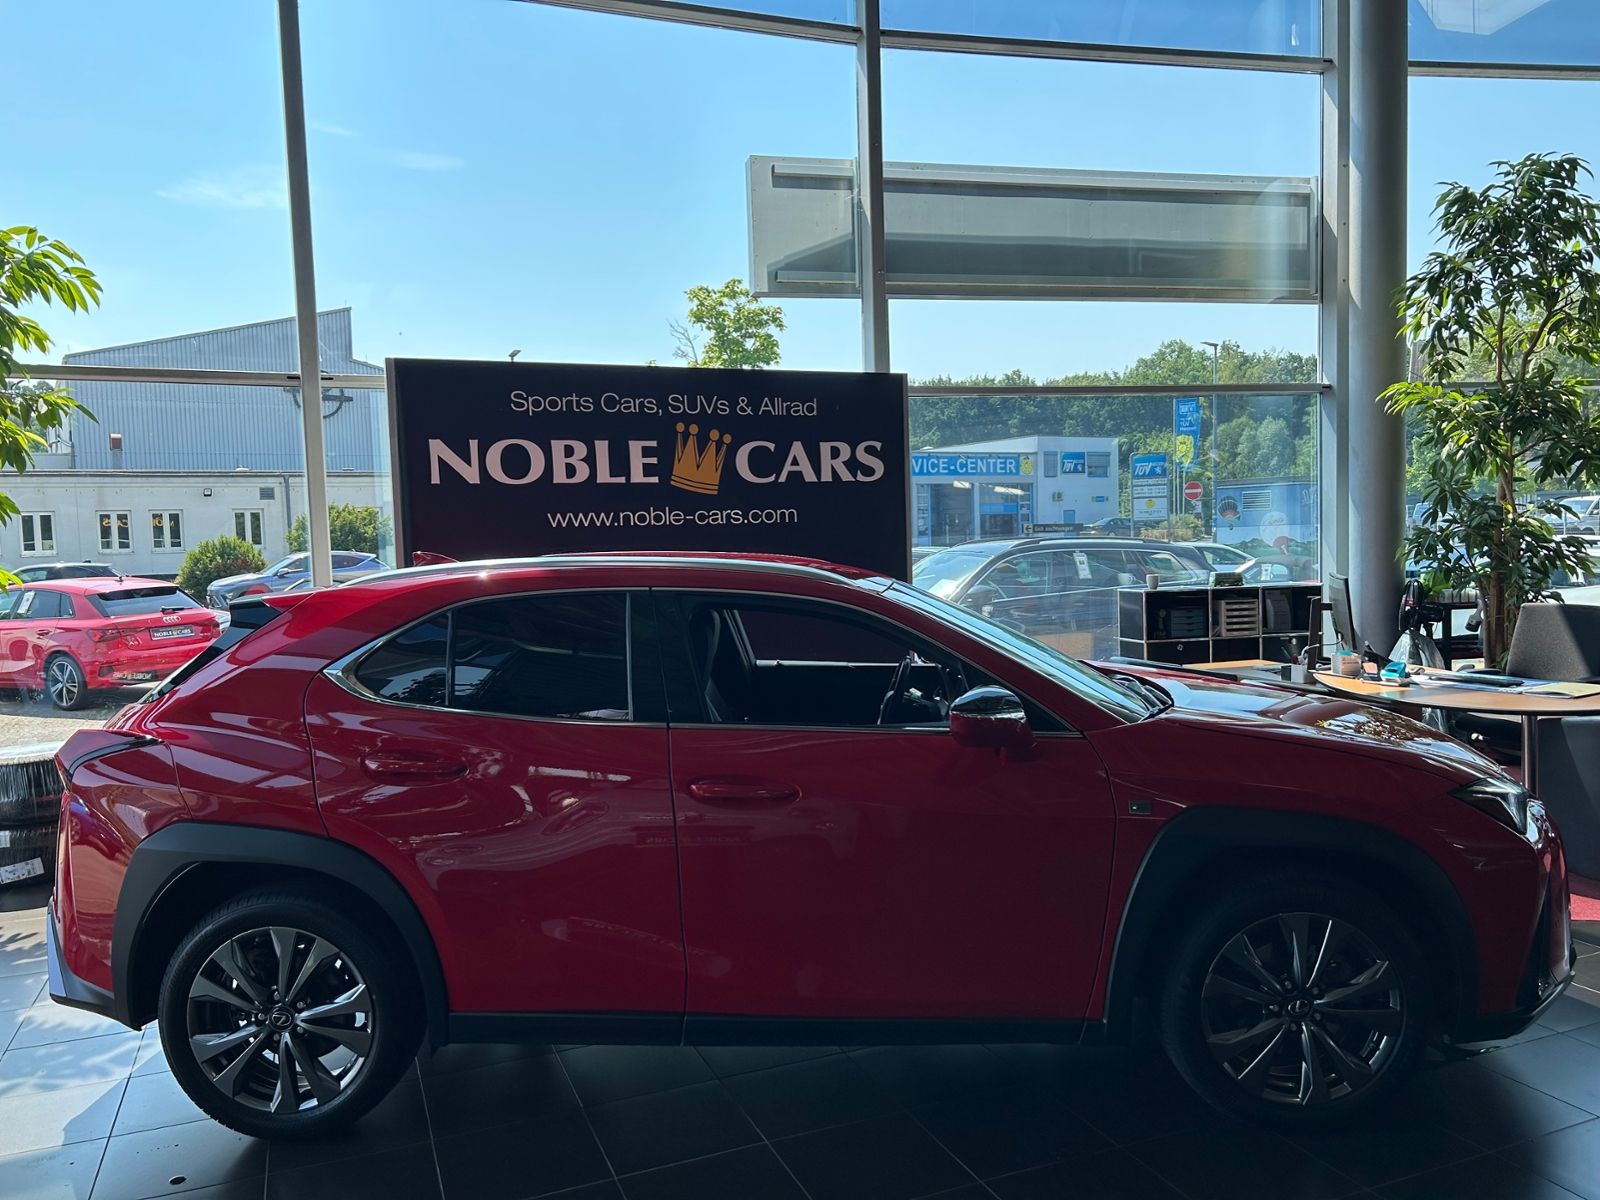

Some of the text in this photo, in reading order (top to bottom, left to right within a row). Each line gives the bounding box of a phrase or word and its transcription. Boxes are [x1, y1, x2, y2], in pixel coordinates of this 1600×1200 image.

[510, 390, 818, 417] Sports Cars, SUVs & Allrad
[428, 438, 886, 485] NOBLE CARS
[912, 457, 1017, 474] VICE-CENTER
[546, 506, 799, 528] www.noble-cars.com
[153, 630, 172, 638] NOBLE
